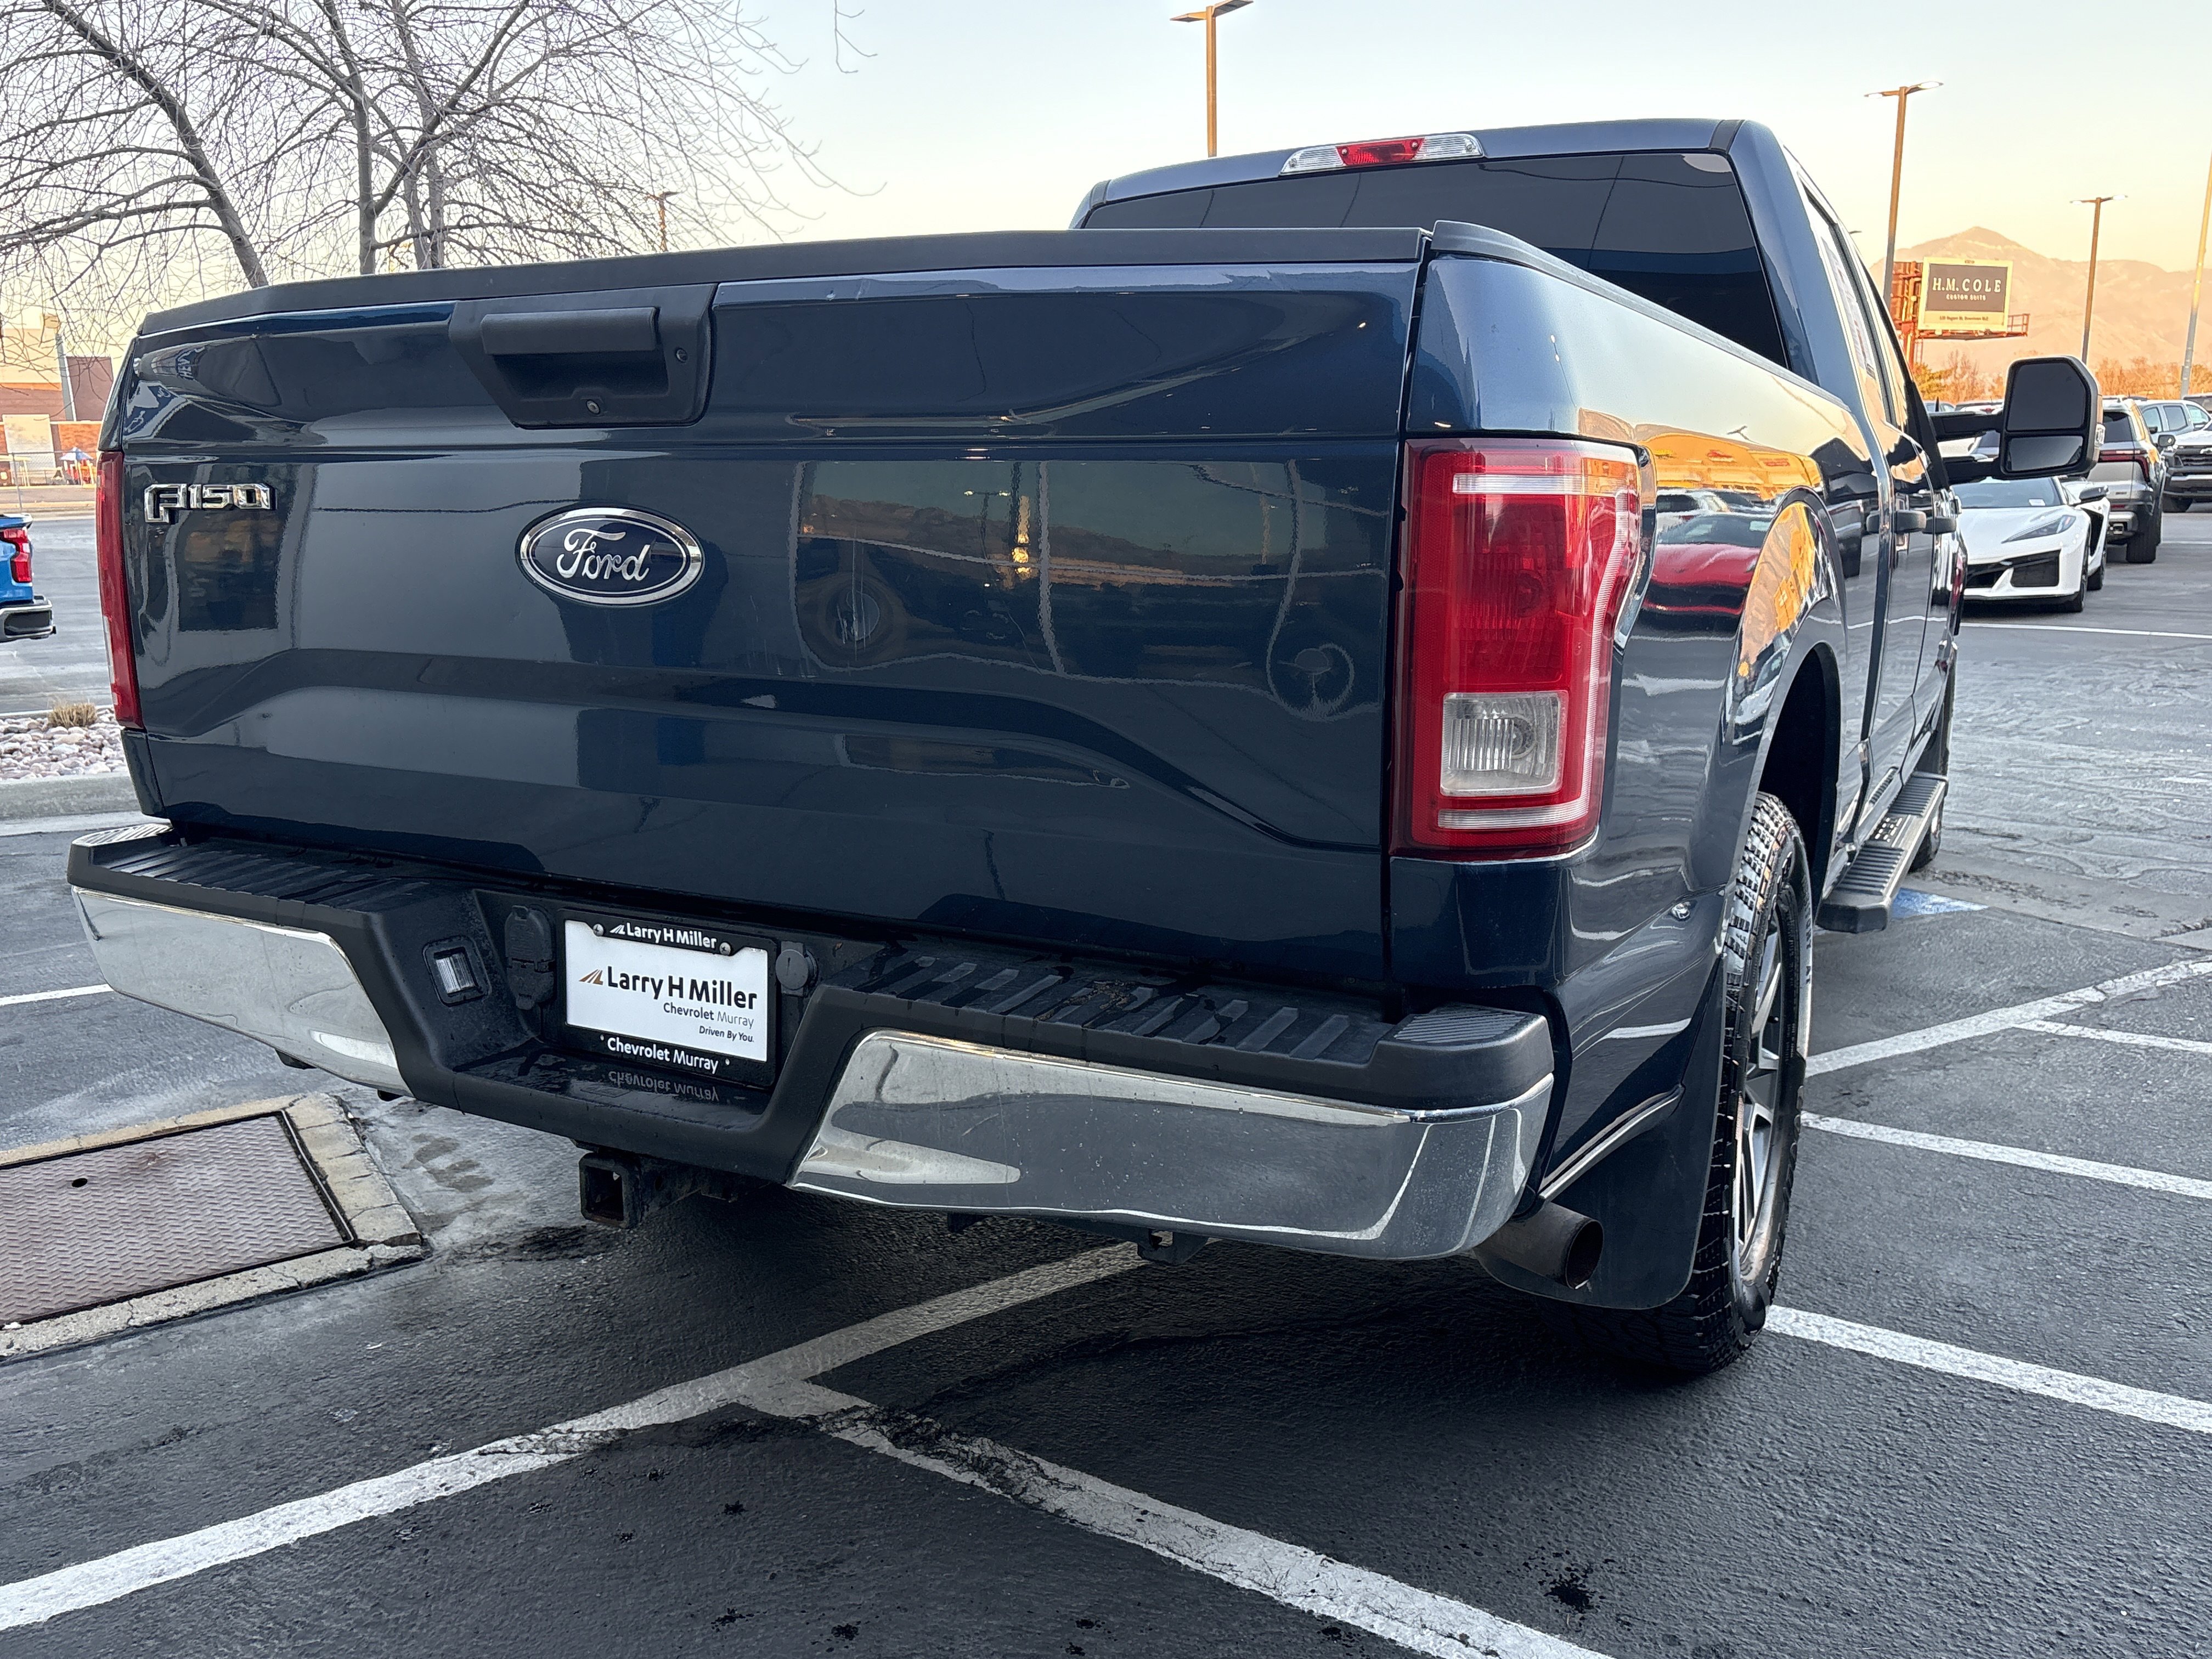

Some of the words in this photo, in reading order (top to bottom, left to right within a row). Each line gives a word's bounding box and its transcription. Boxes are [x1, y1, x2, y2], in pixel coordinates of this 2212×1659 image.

[1932, 277, 1959, 291] H.M.
[1962, 278, 2001, 292] COLE
[556, 528, 651, 582] Ford
[626, 922, 661, 944] Larry
[663, 928, 674, 943] H
[676, 929, 717, 949] Miller
[607, 966, 663, 1000] Larry
[668, 975, 684, 998] H
[689, 979, 757, 1010] Miller
[663, 1002, 714, 1020] Chevrolet
[716, 1011, 754, 1030] Murray
[698, 1025, 725, 1038] Driven
[727, 1030, 737, 1042] By
[607, 1037, 670, 1062] Chevrolet
[673, 1049, 719, 1074] Murray
